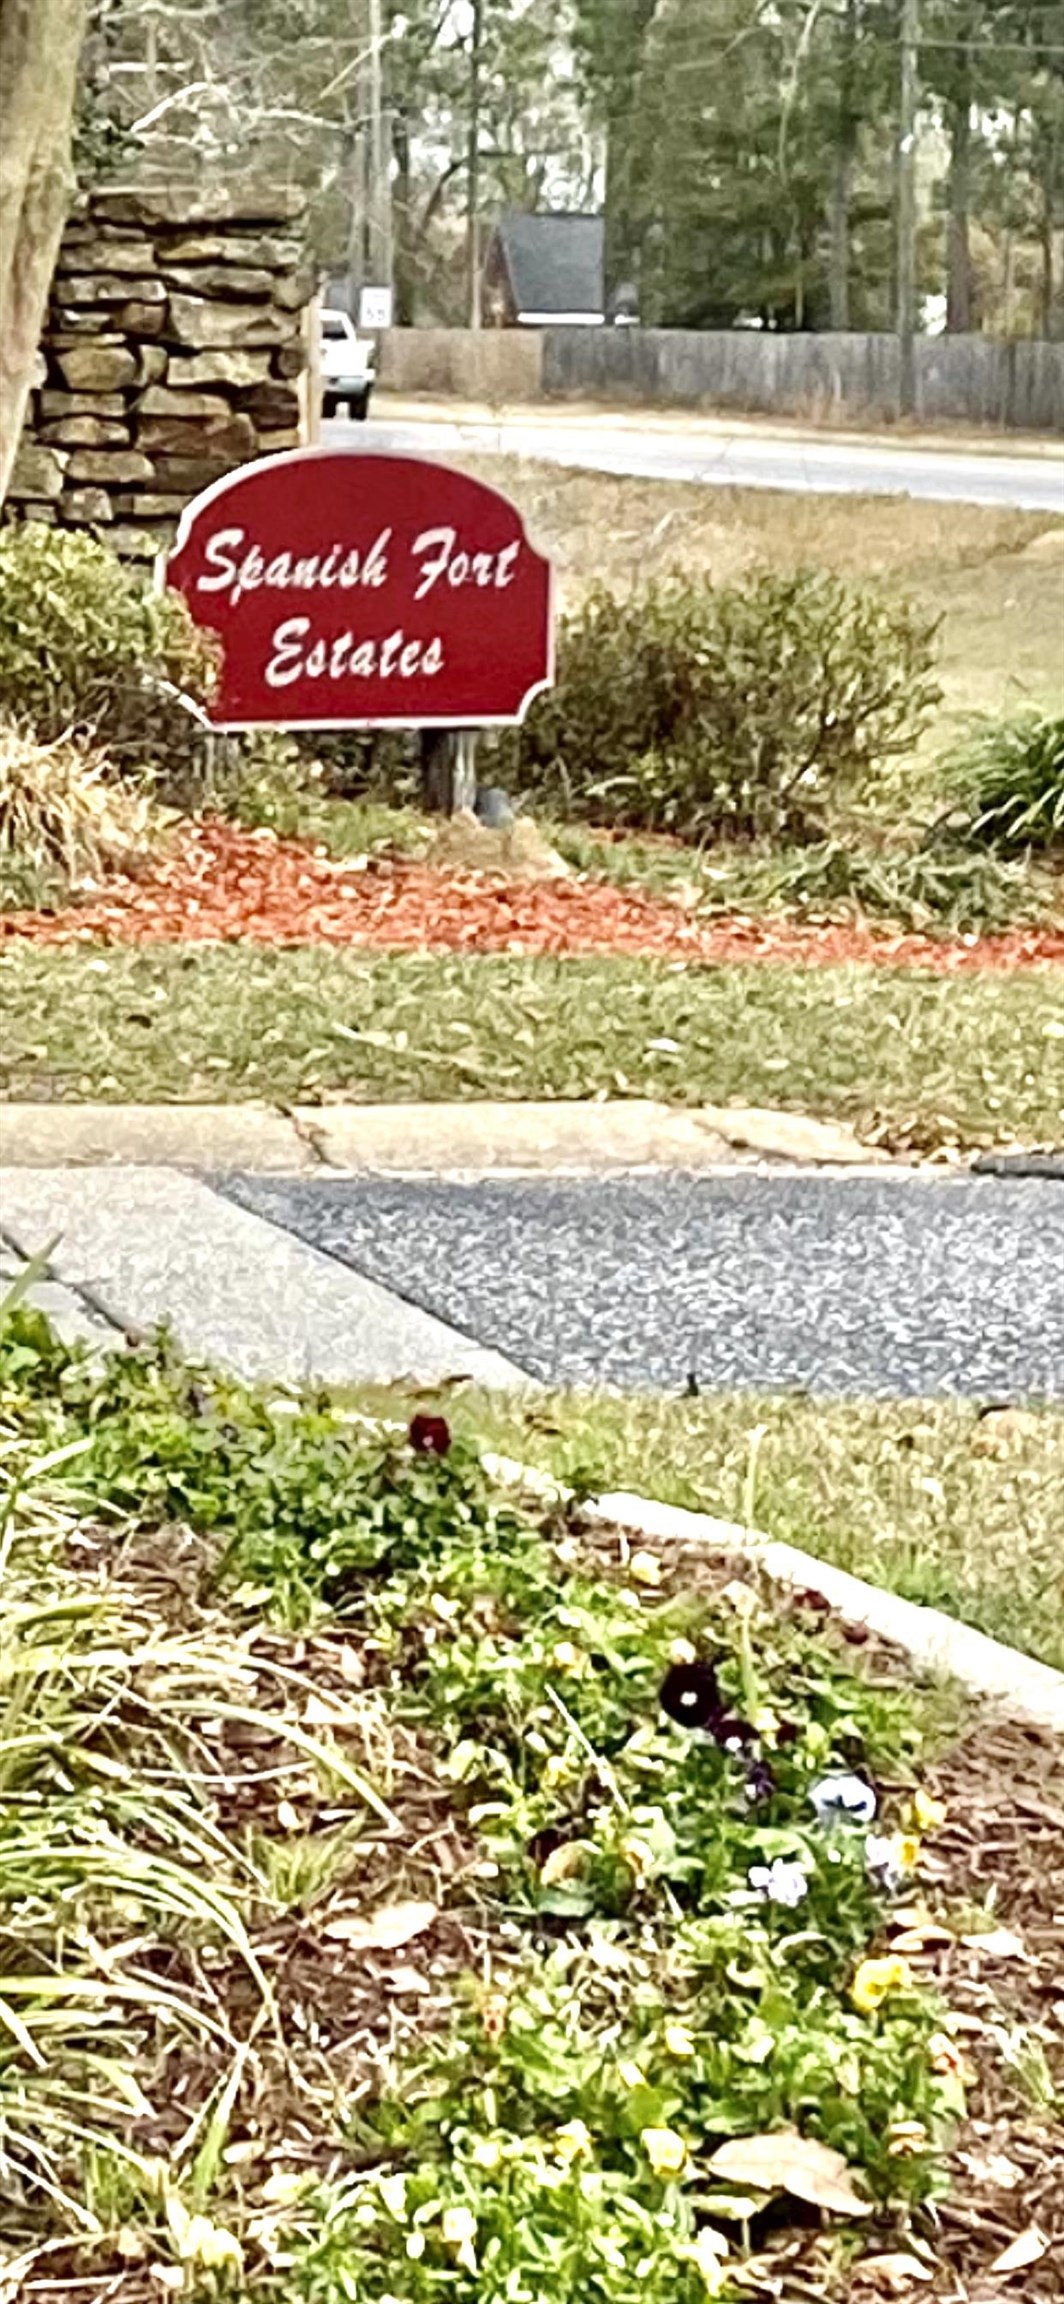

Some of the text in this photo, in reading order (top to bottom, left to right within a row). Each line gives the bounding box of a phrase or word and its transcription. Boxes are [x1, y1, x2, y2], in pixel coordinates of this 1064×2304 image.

[197, 526, 521, 606] Spanish Fort
[264, 617, 445, 688] Estates
